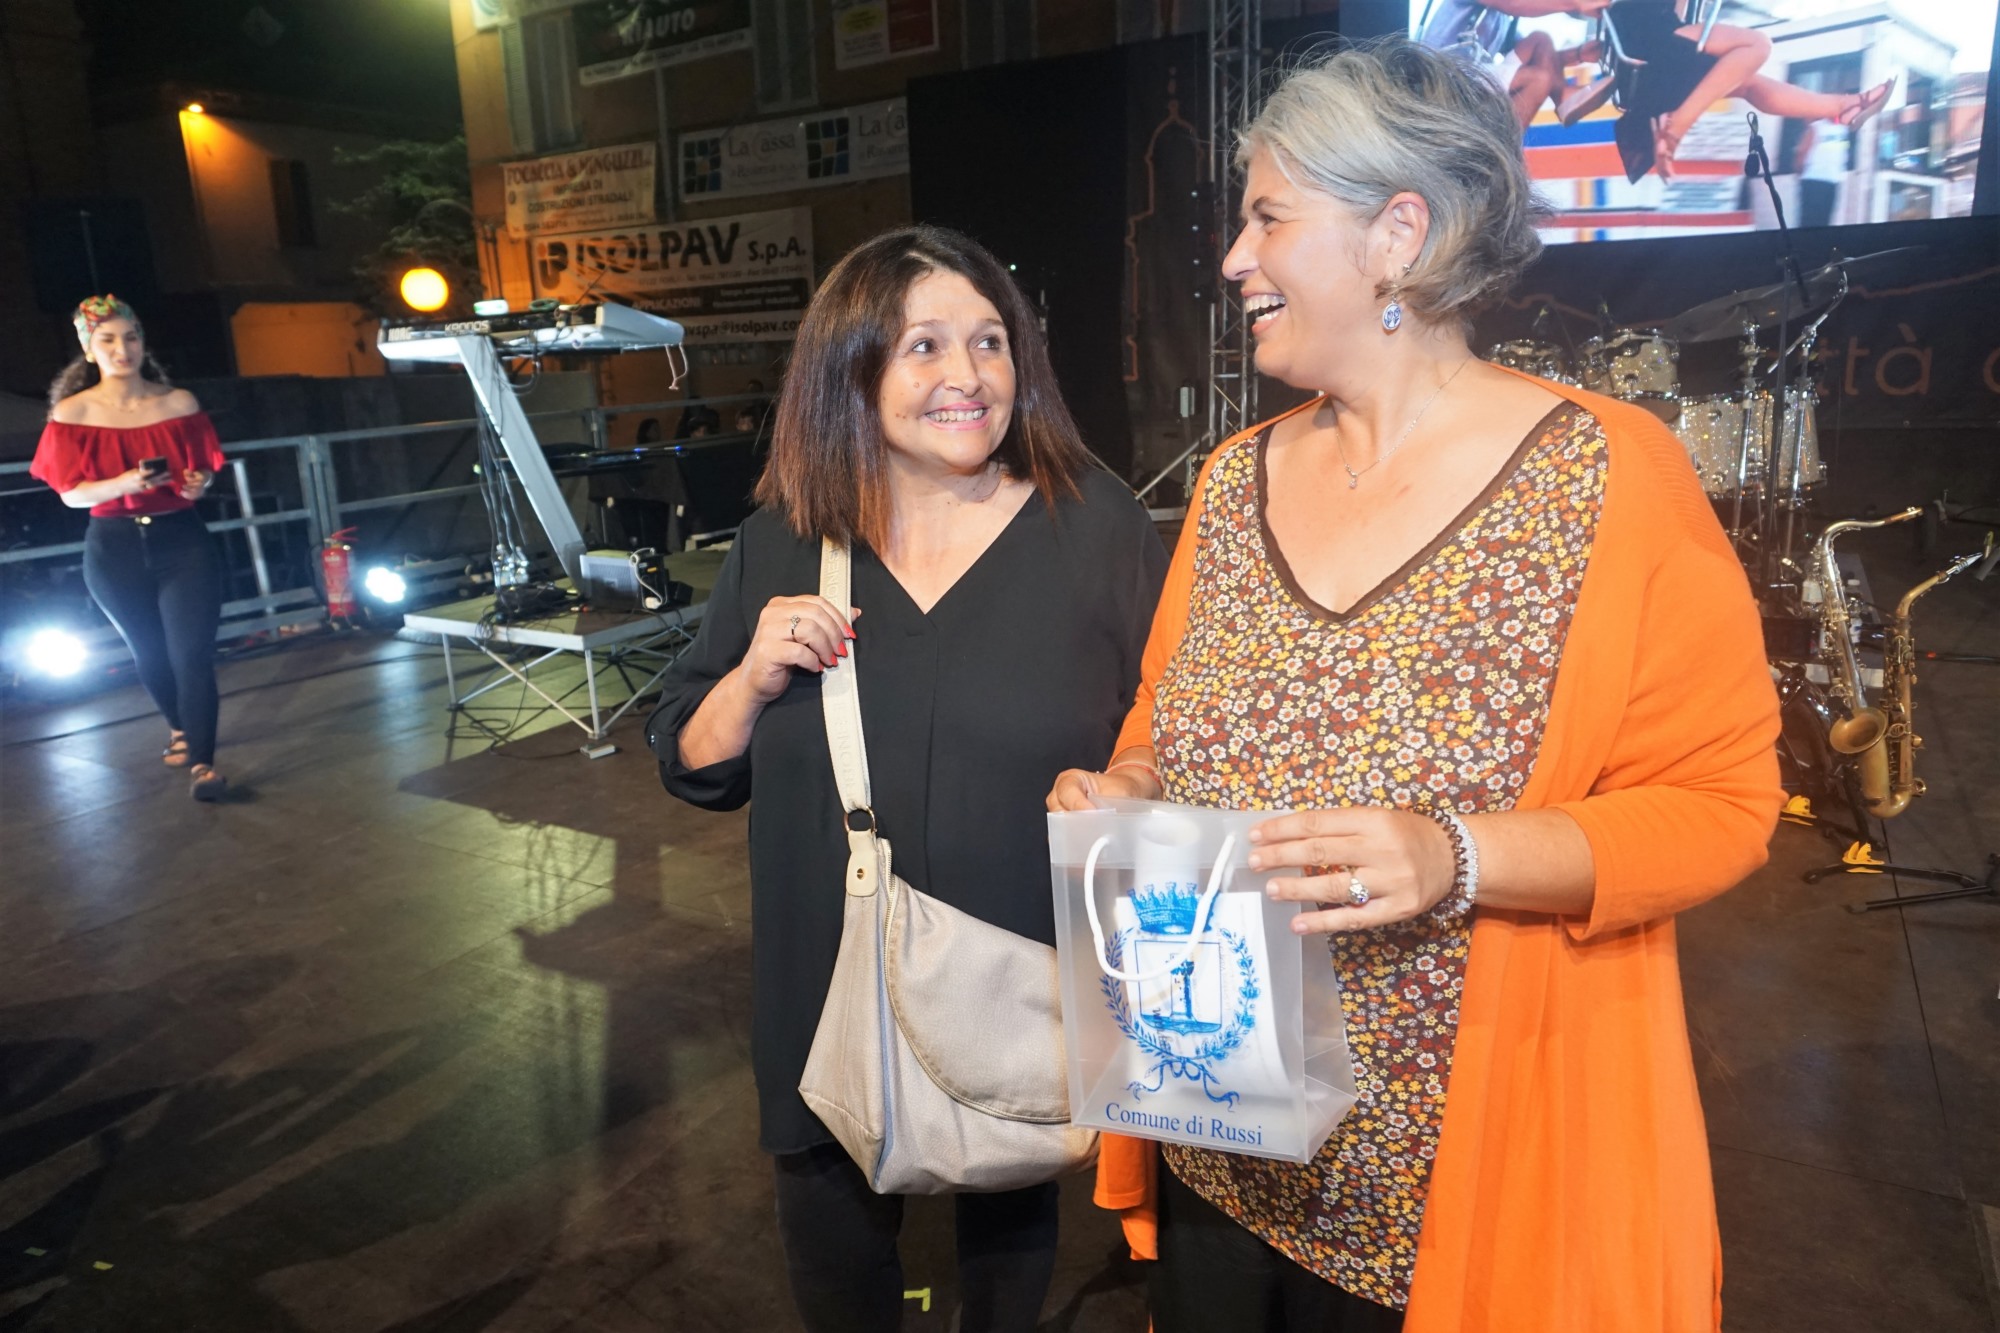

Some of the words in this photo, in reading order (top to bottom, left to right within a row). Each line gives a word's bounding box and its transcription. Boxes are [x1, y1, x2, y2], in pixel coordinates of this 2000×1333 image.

[858, 115, 881, 137] La
[753, 130, 796, 161] Cassa
[507, 160, 564, 185] FOCACCIA
[593, 178, 603, 190] DI
[576, 222, 740, 274] ISOLPAV
[445, 319, 490, 333] KRONOS
[1105, 1101, 1181, 1132] Comune
[1186, 1115, 1204, 1136] di
[1210, 1118, 1264, 1146] Russi
